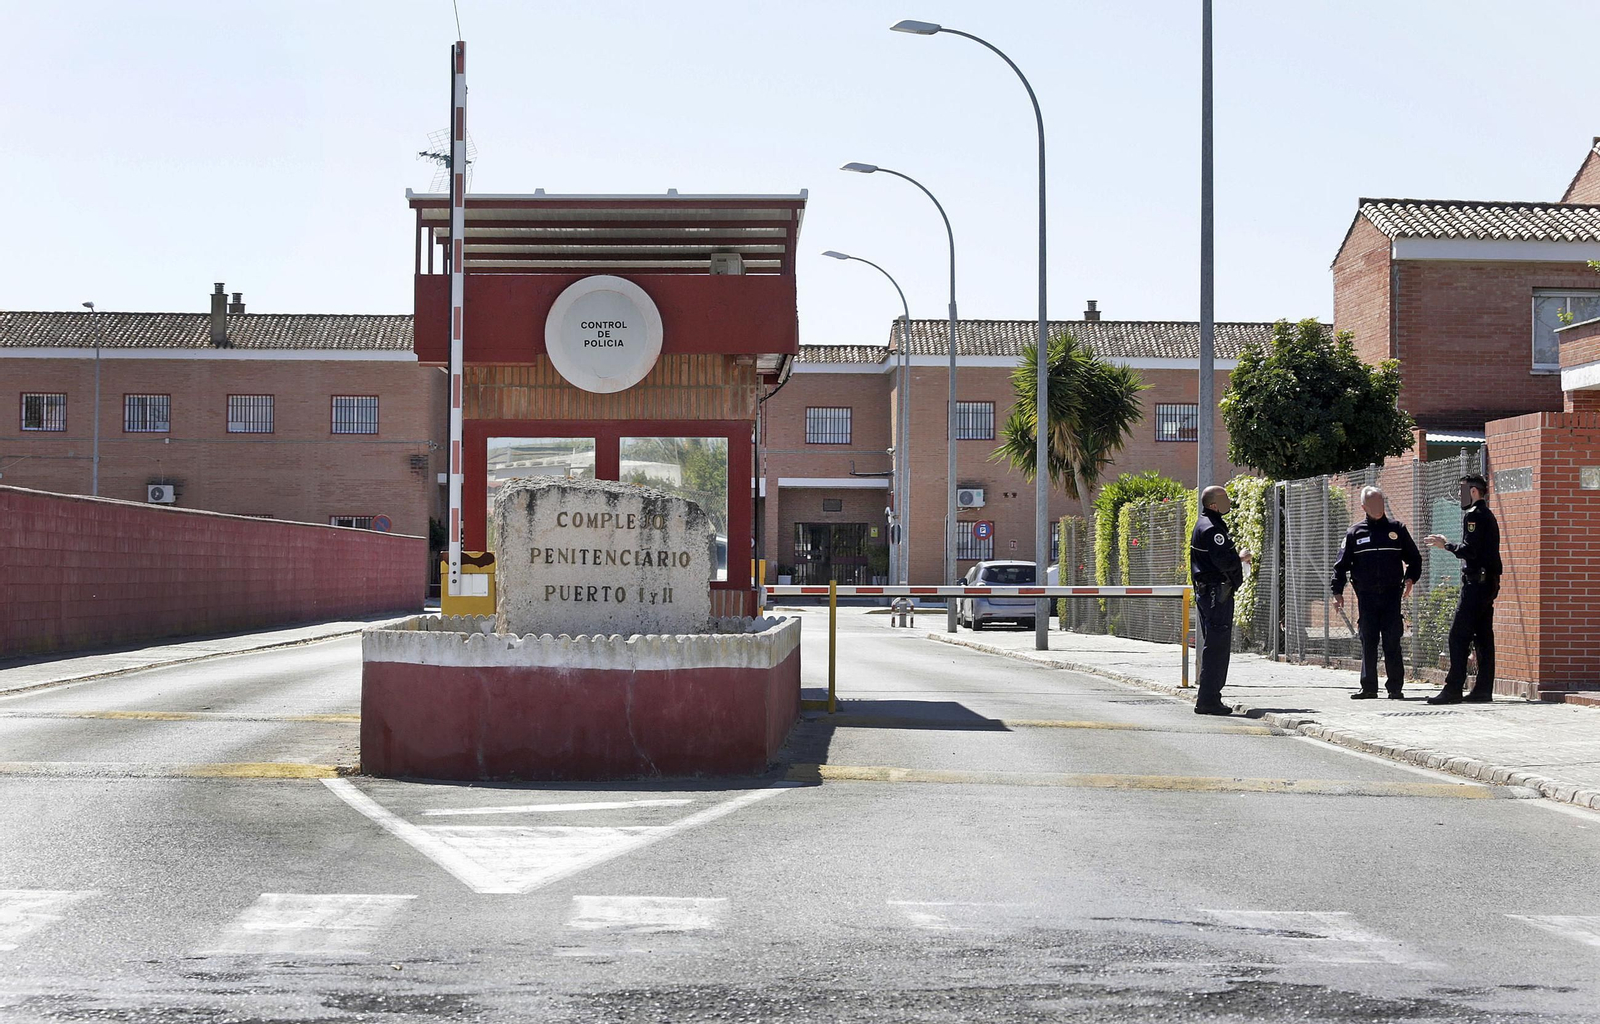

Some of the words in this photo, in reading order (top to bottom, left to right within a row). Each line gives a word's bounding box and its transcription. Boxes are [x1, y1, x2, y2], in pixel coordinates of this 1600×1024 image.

[581, 321, 627, 329] CONTROL
[556, 511, 665, 530] COMPLEJO
[530, 547, 691, 568] PENITENCIARIO
[544, 585, 626, 603] PUERTO
